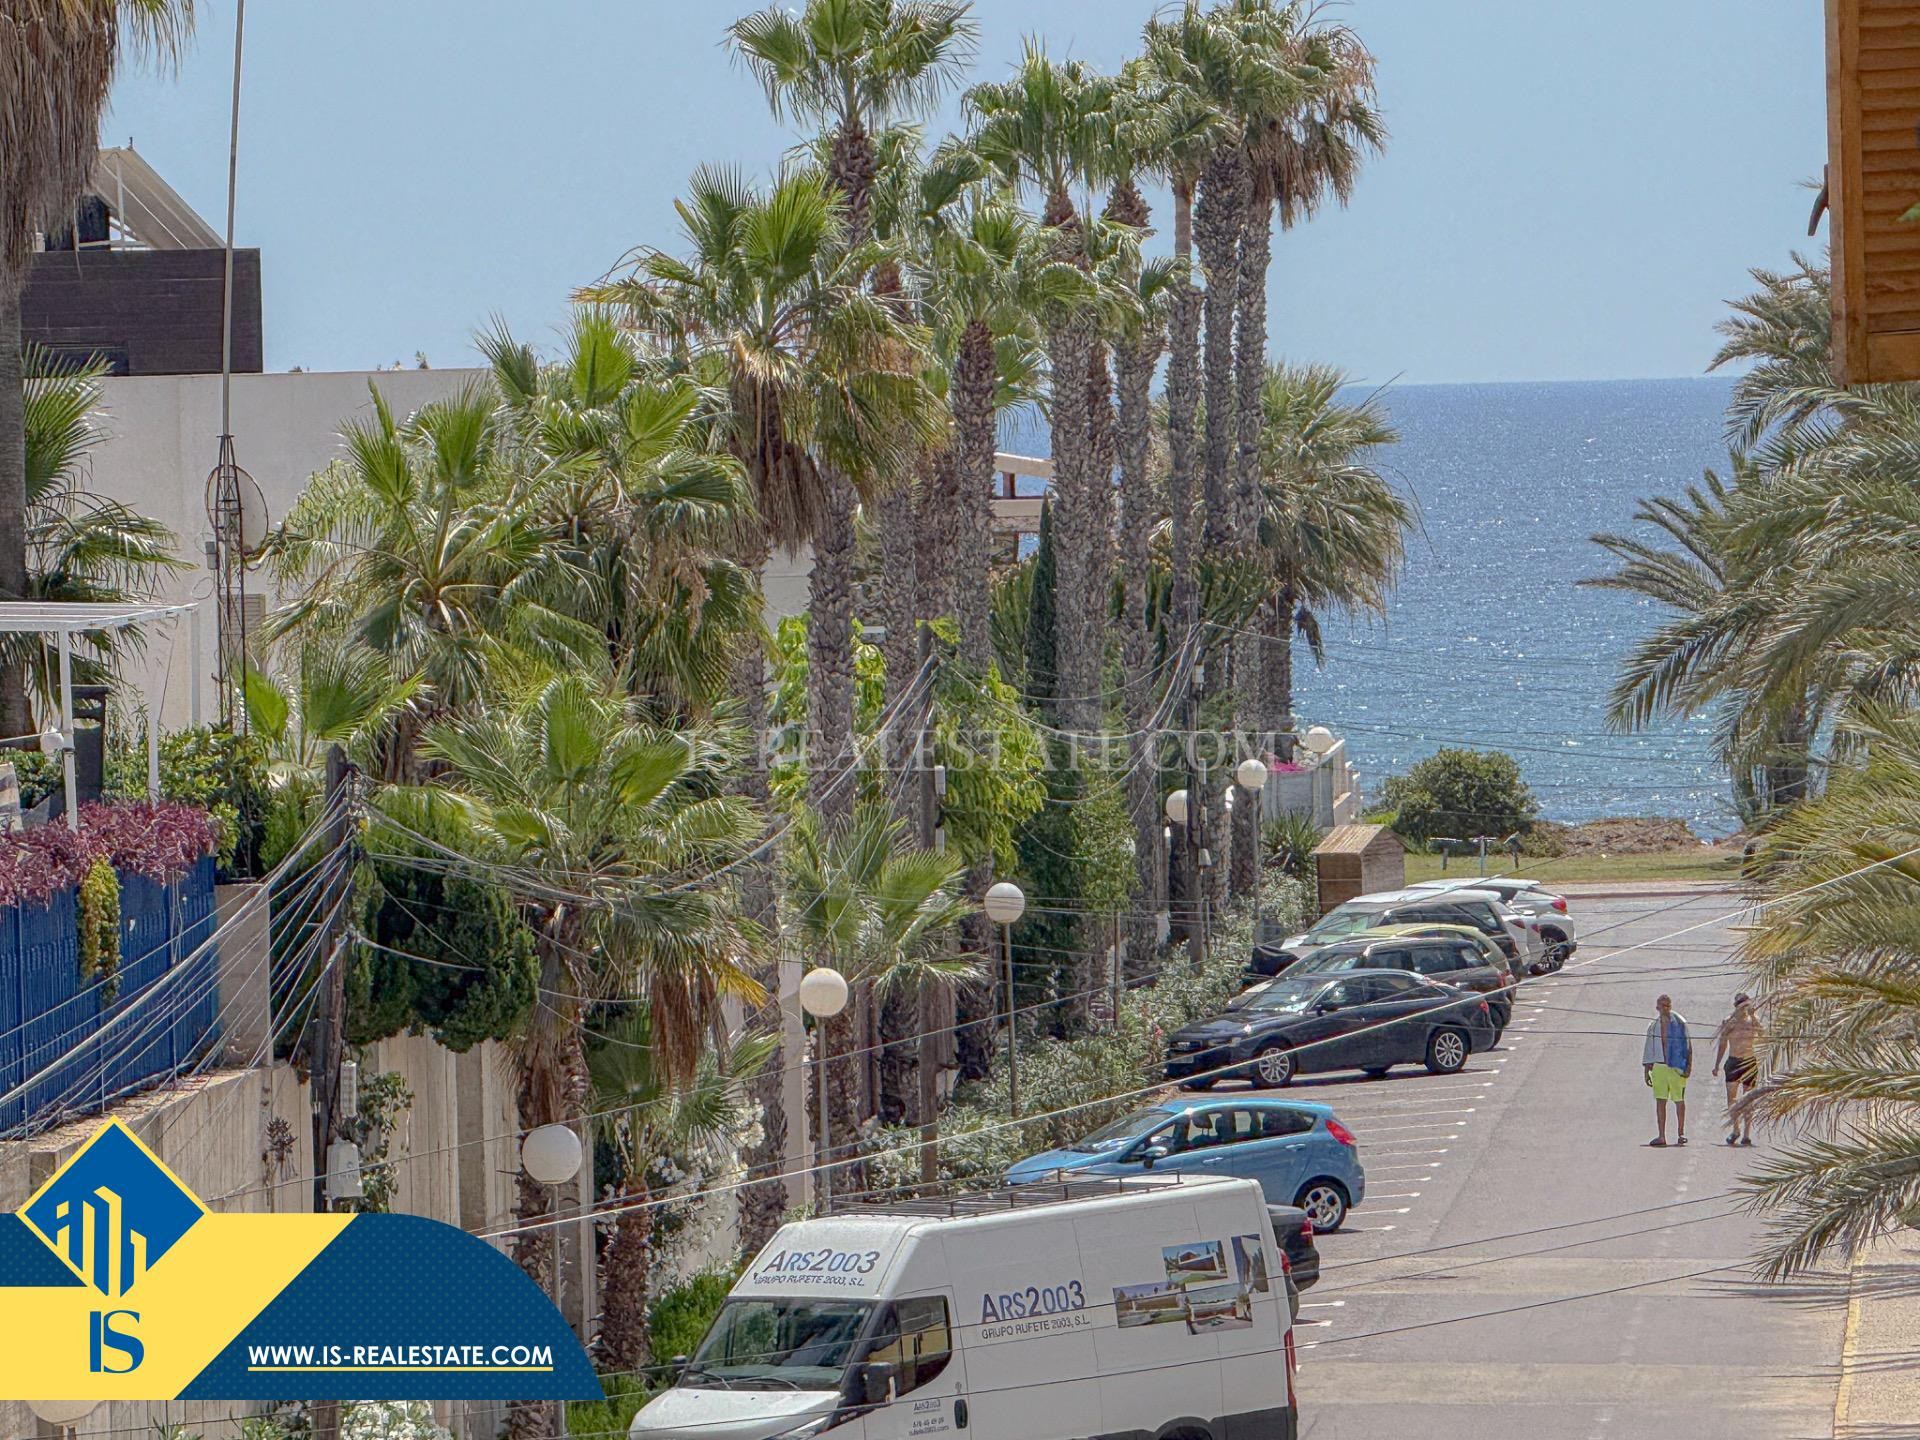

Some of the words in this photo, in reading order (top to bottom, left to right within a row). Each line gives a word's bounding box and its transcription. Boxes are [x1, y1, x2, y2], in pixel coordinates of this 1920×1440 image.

[762, 1248, 880, 1273] ARS2003
[981, 1280, 1086, 1323] ARS2003
[981, 1325, 1014, 1339] GRUPO
[1015, 1320, 1050, 1334] RUFETE
